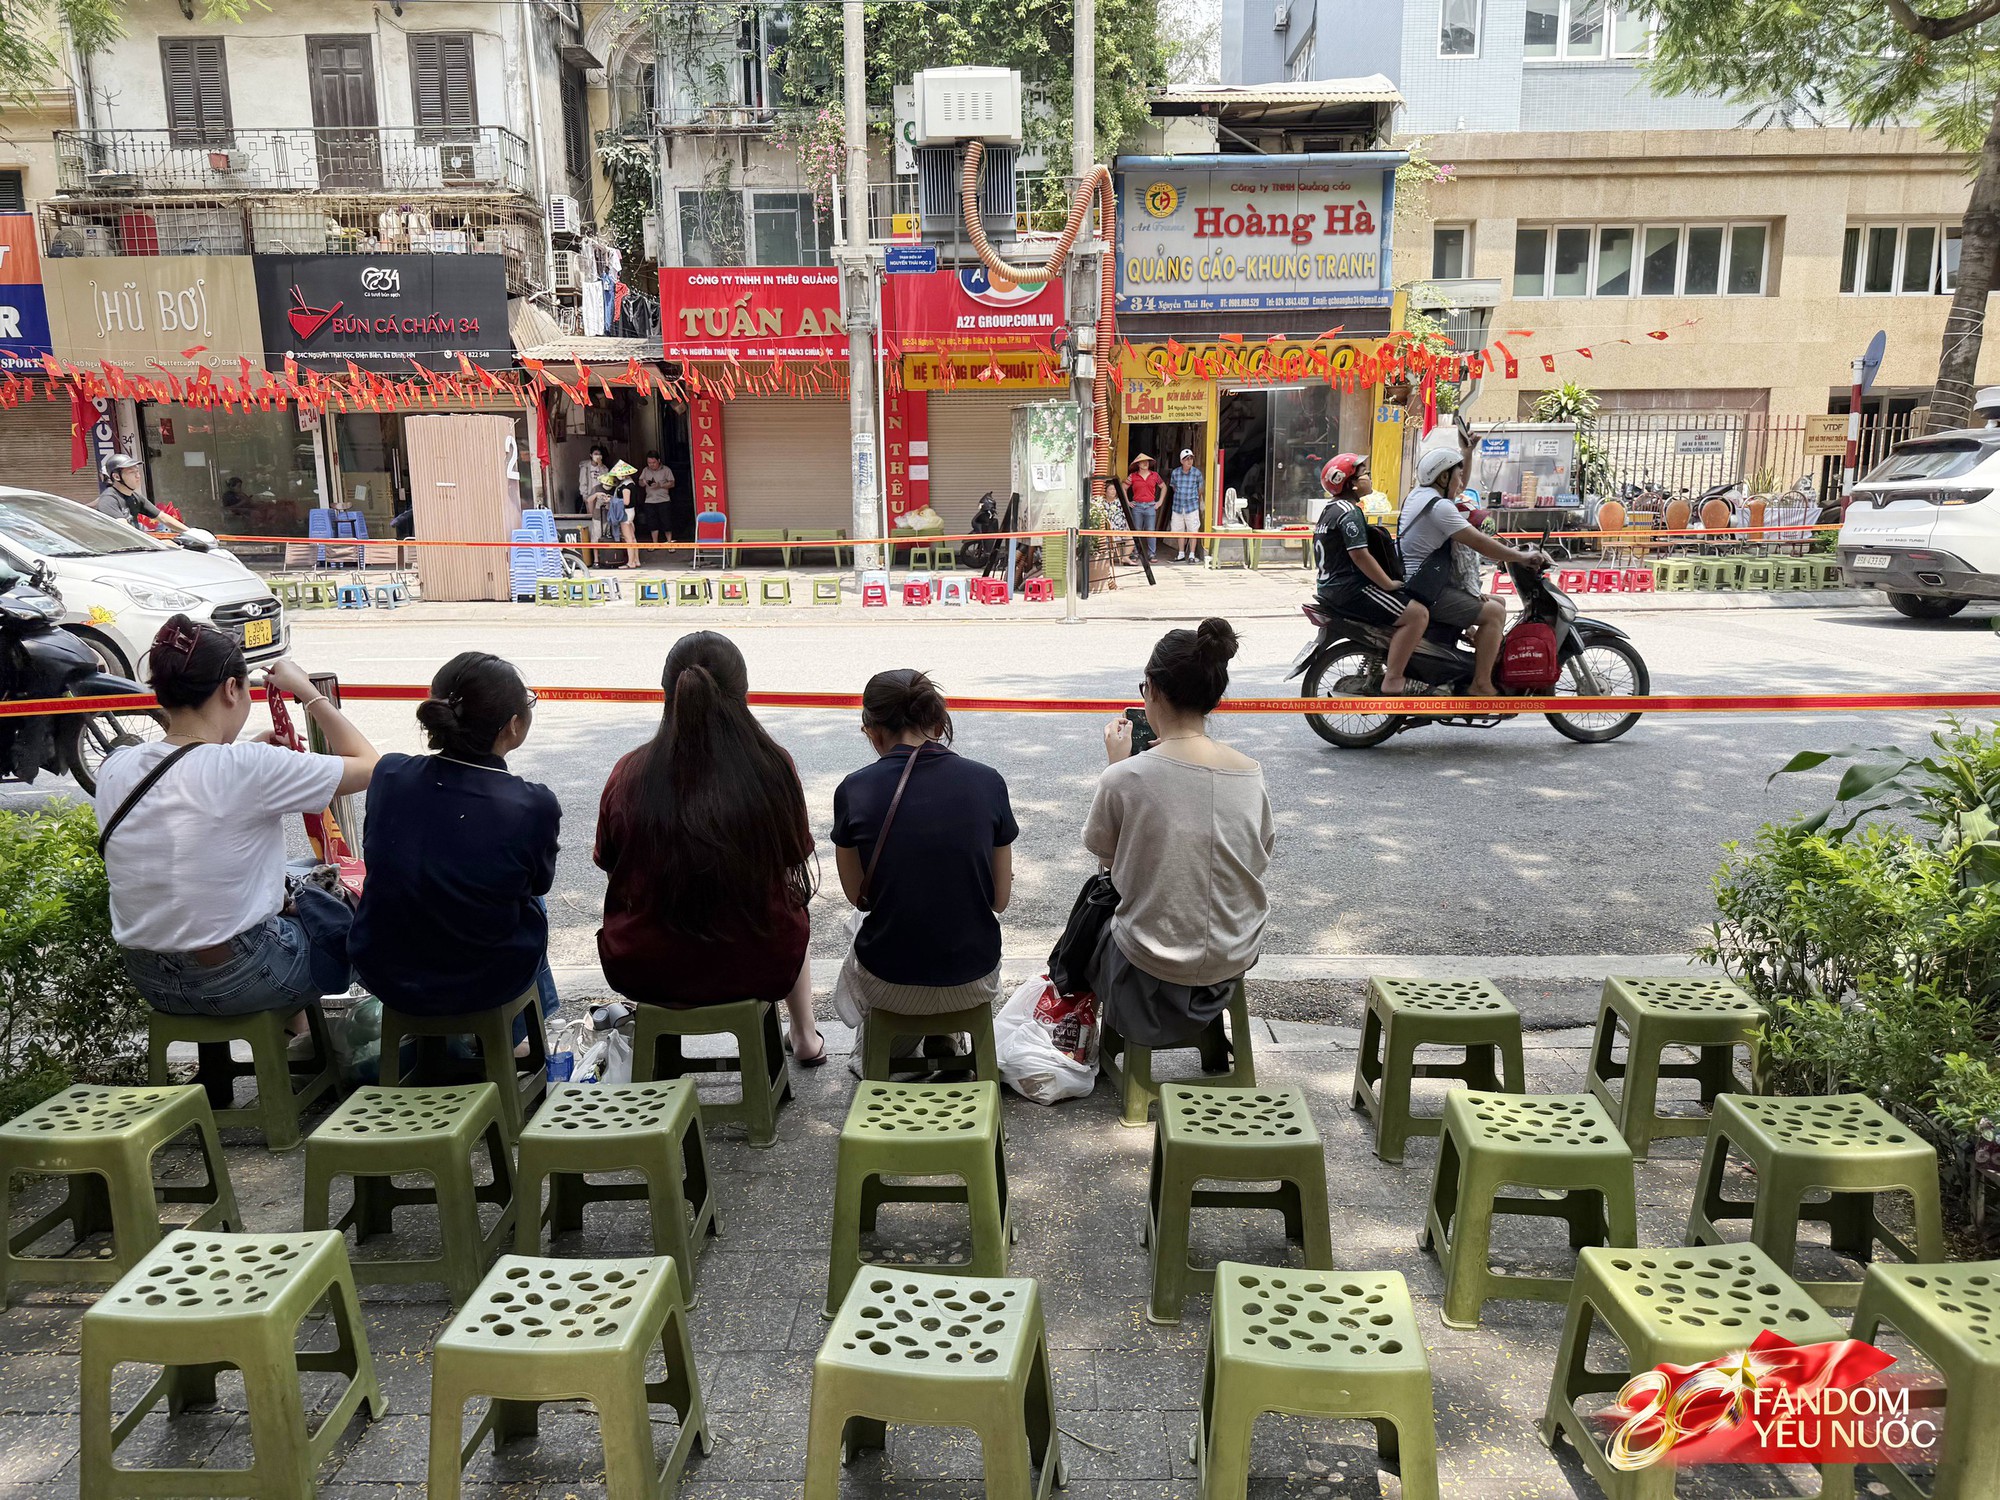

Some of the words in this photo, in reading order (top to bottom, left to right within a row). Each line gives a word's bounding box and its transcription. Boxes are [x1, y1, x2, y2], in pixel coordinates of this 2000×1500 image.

[1231, 182, 1256, 193] Công
[1260, 183, 1269, 193] ty
[1272, 183, 1295, 192] TNHH
[1298, 181, 1330, 192] Quảng
[1333, 181, 1351, 191] cáo
[1193, 203, 1316, 244] Hoàng
[1324, 200, 1376, 235] Hà
[1127, 244, 1193, 283] QUẢNG
[1316, 253, 1376, 280] TRANH
[688, 273, 719, 285] CÔNG
[721, 276, 732, 285] TY
[733, 275, 761, 285] TNHH
[764, 275, 773, 285] IN
[776, 273, 799, 285] THÊU
[801, 272, 839, 285] QUẢNG
[101, 281, 145, 331] HŨ
[1131, 296, 1156, 311] 34
[1158, 298, 1181, 310] Nguyễn
[1184, 299, 1198, 309] Thái
[1201, 299, 1214, 309] Học
[332, 313, 370, 334] BÚN
[374, 313, 399, 334] CÁ
[401, 311, 455, 334] CHẤM
[459, 318, 480, 333] 34
[679, 292, 784, 337] TUẤN
[796, 308, 848, 337] AN
[956, 316, 976, 328] A2Z
[978, 314, 1054, 328] GROUP.COM.VN
[689, 346, 713, 356] NGUYỄN
[759, 348, 766, 356] 11
[913, 362, 927, 383] HỆ
[1128, 382, 1144, 393] 34
[1125, 389, 1164, 414] Lẩu
[1377, 405, 1401, 423] 34
[1823, 423, 1844, 431] VTDF
[504, 435, 521, 481] 2
[582, 692, 603, 700] QUA
[610, 693, 643, 701] POLICE
[1355, 701, 1382, 710] VƯỢT
[1413, 701, 1447, 709] POLICE
[1476, 701, 1489, 709] DO
[1492, 701, 1511, 709] NOT
[1513, 701, 1546, 709] CROSS
